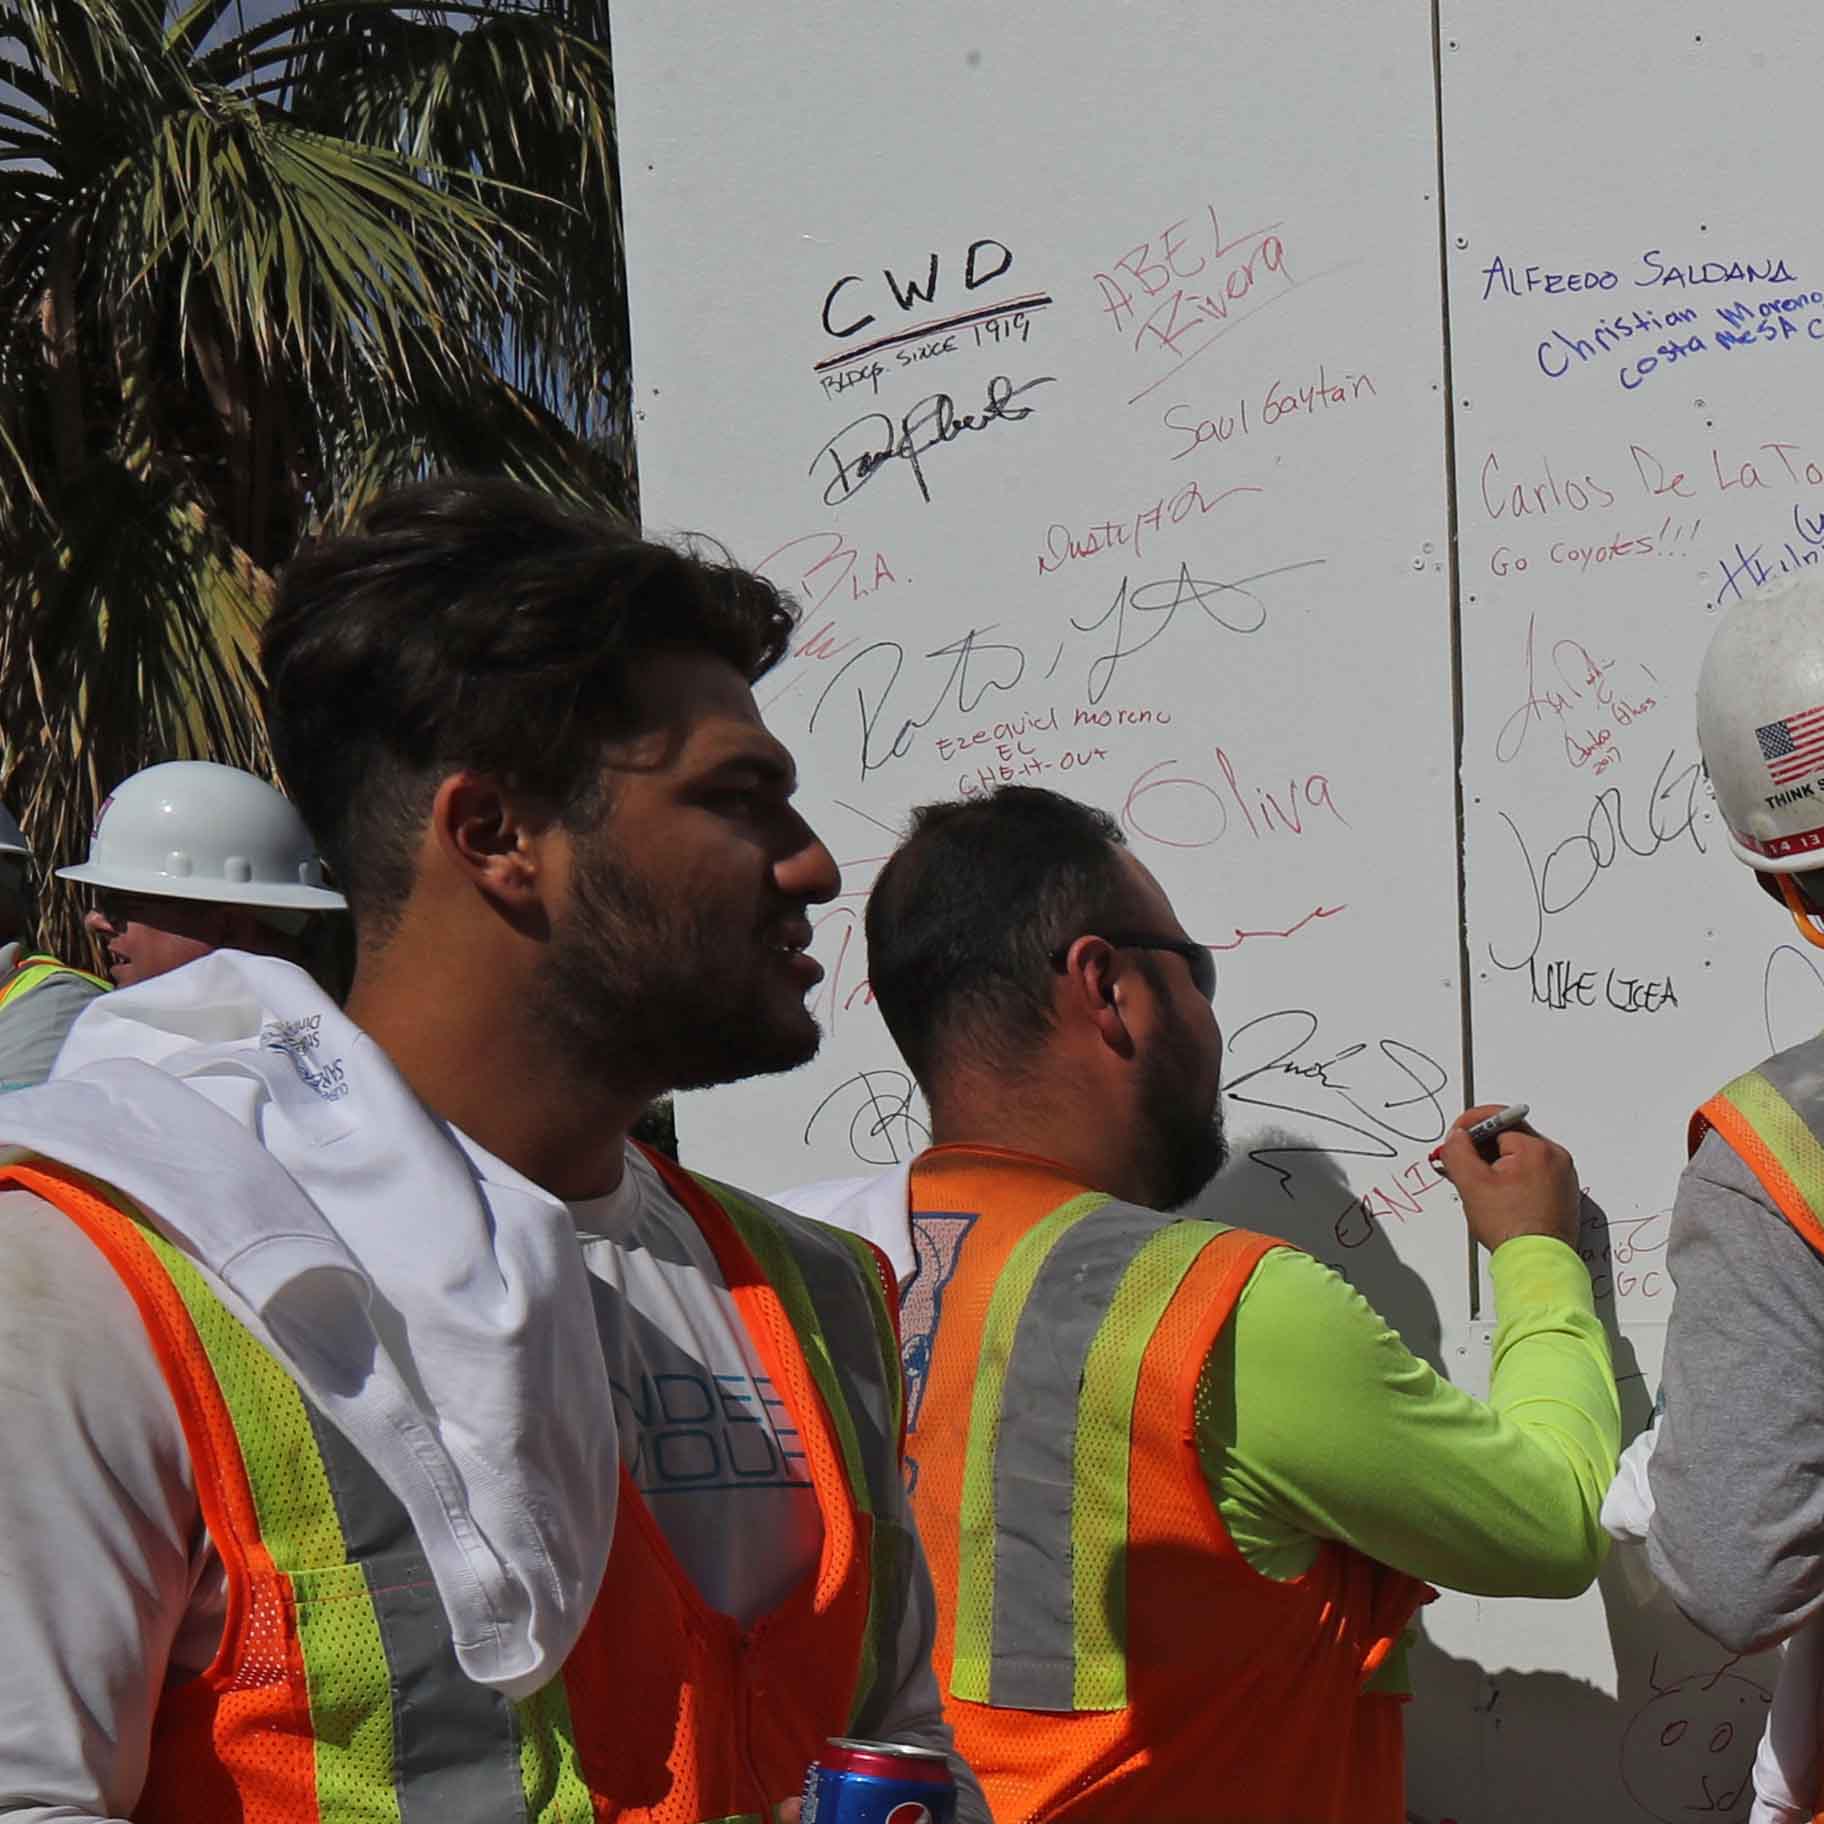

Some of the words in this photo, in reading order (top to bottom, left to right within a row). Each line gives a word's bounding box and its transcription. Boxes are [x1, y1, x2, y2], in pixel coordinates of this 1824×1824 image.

[1093, 205, 1284, 332] ABEL
[1482, 255, 1618, 299] ALFREDO
[1634, 250, 1800, 287] SALDANA
[974, 312, 1031, 347] 1919
[1537, 306, 1697, 378] Christian
[1715, 289, 1824, 329] Moreno
[1481, 451, 1616, 519] Carlos
[1629, 445, 1697, 498] De
[1711, 449, 1767, 491] La
[1763, 783, 1817, 811] THINK
[1801, 832, 1821, 848] 13
[1530, 955, 1597, 1011] MIKE
